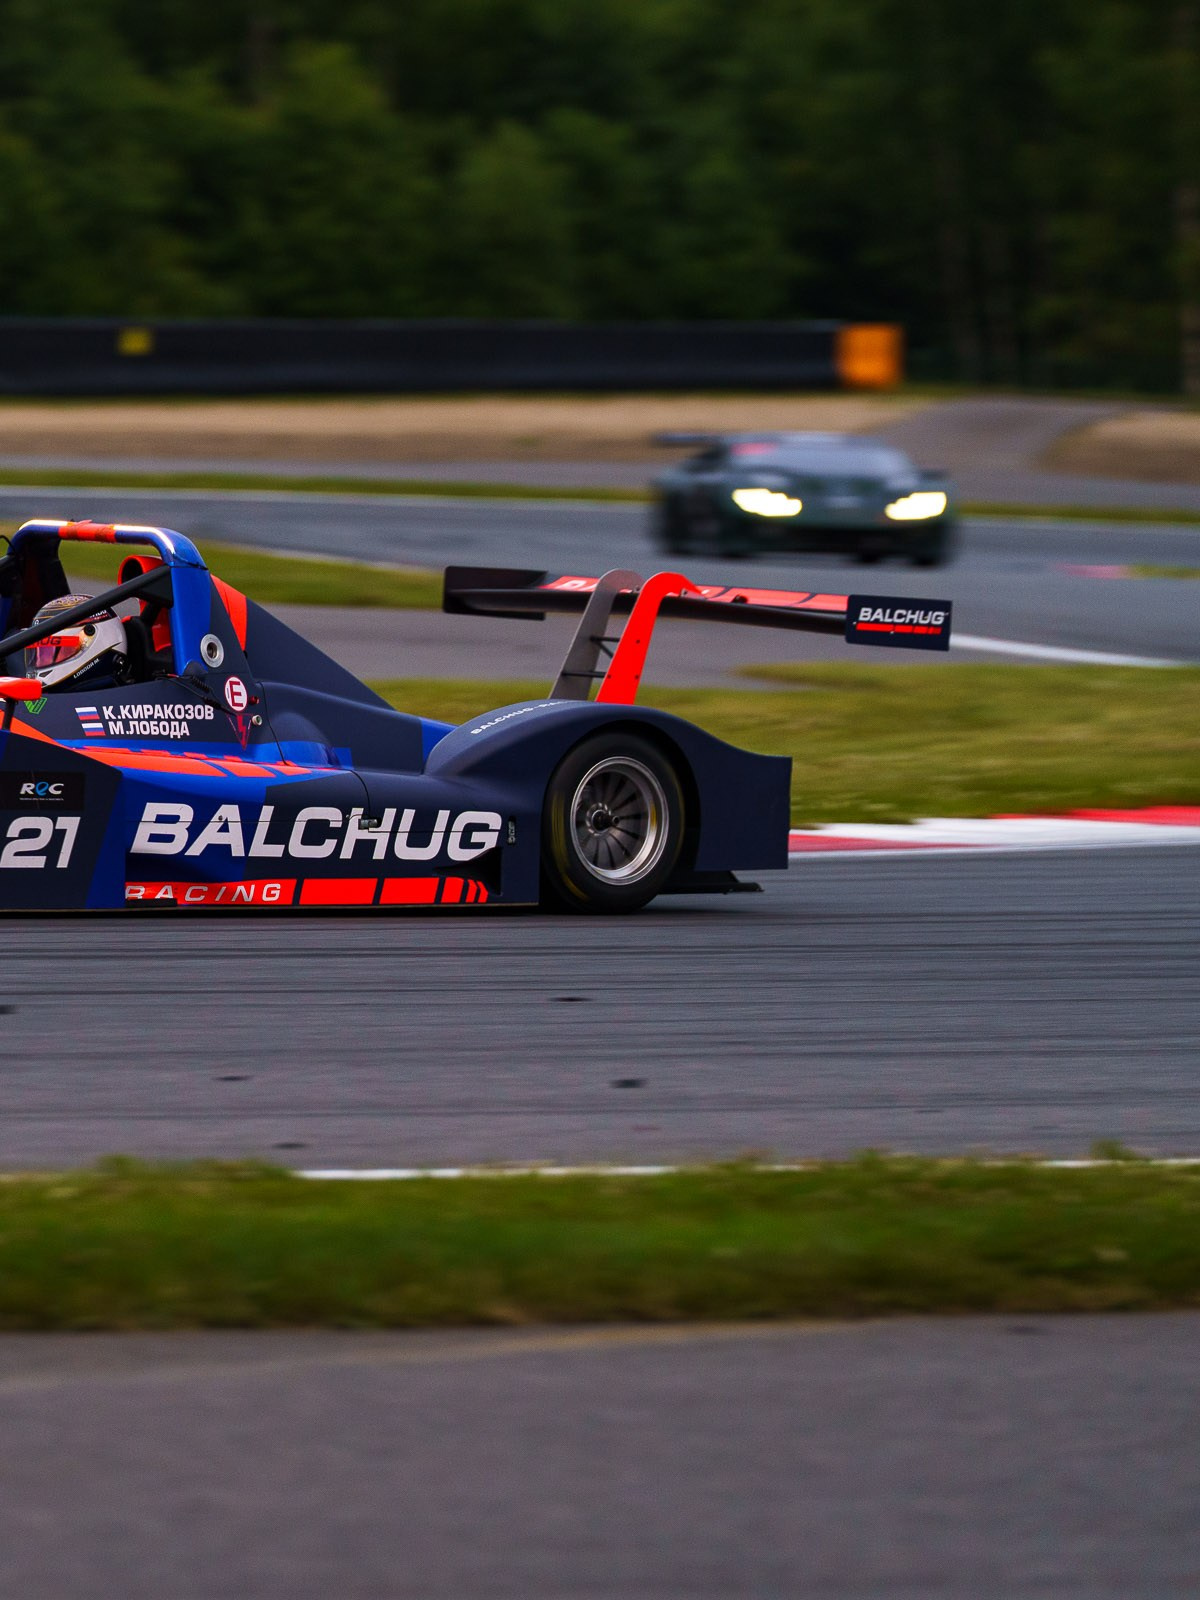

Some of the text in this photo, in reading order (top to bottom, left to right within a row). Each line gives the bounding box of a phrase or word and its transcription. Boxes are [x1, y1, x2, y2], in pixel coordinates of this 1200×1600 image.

[858, 607, 945, 625] BALCHUG
[229, 680, 244, 707] E
[102, 704, 214, 720] К.КИРАКОЗОВ
[108, 721, 190, 738] М.ЛОБОДА
[130, 802, 503, 861] BALCHUG
[0, 816, 81, 868] 21
[125, 883, 281, 902] RACING
